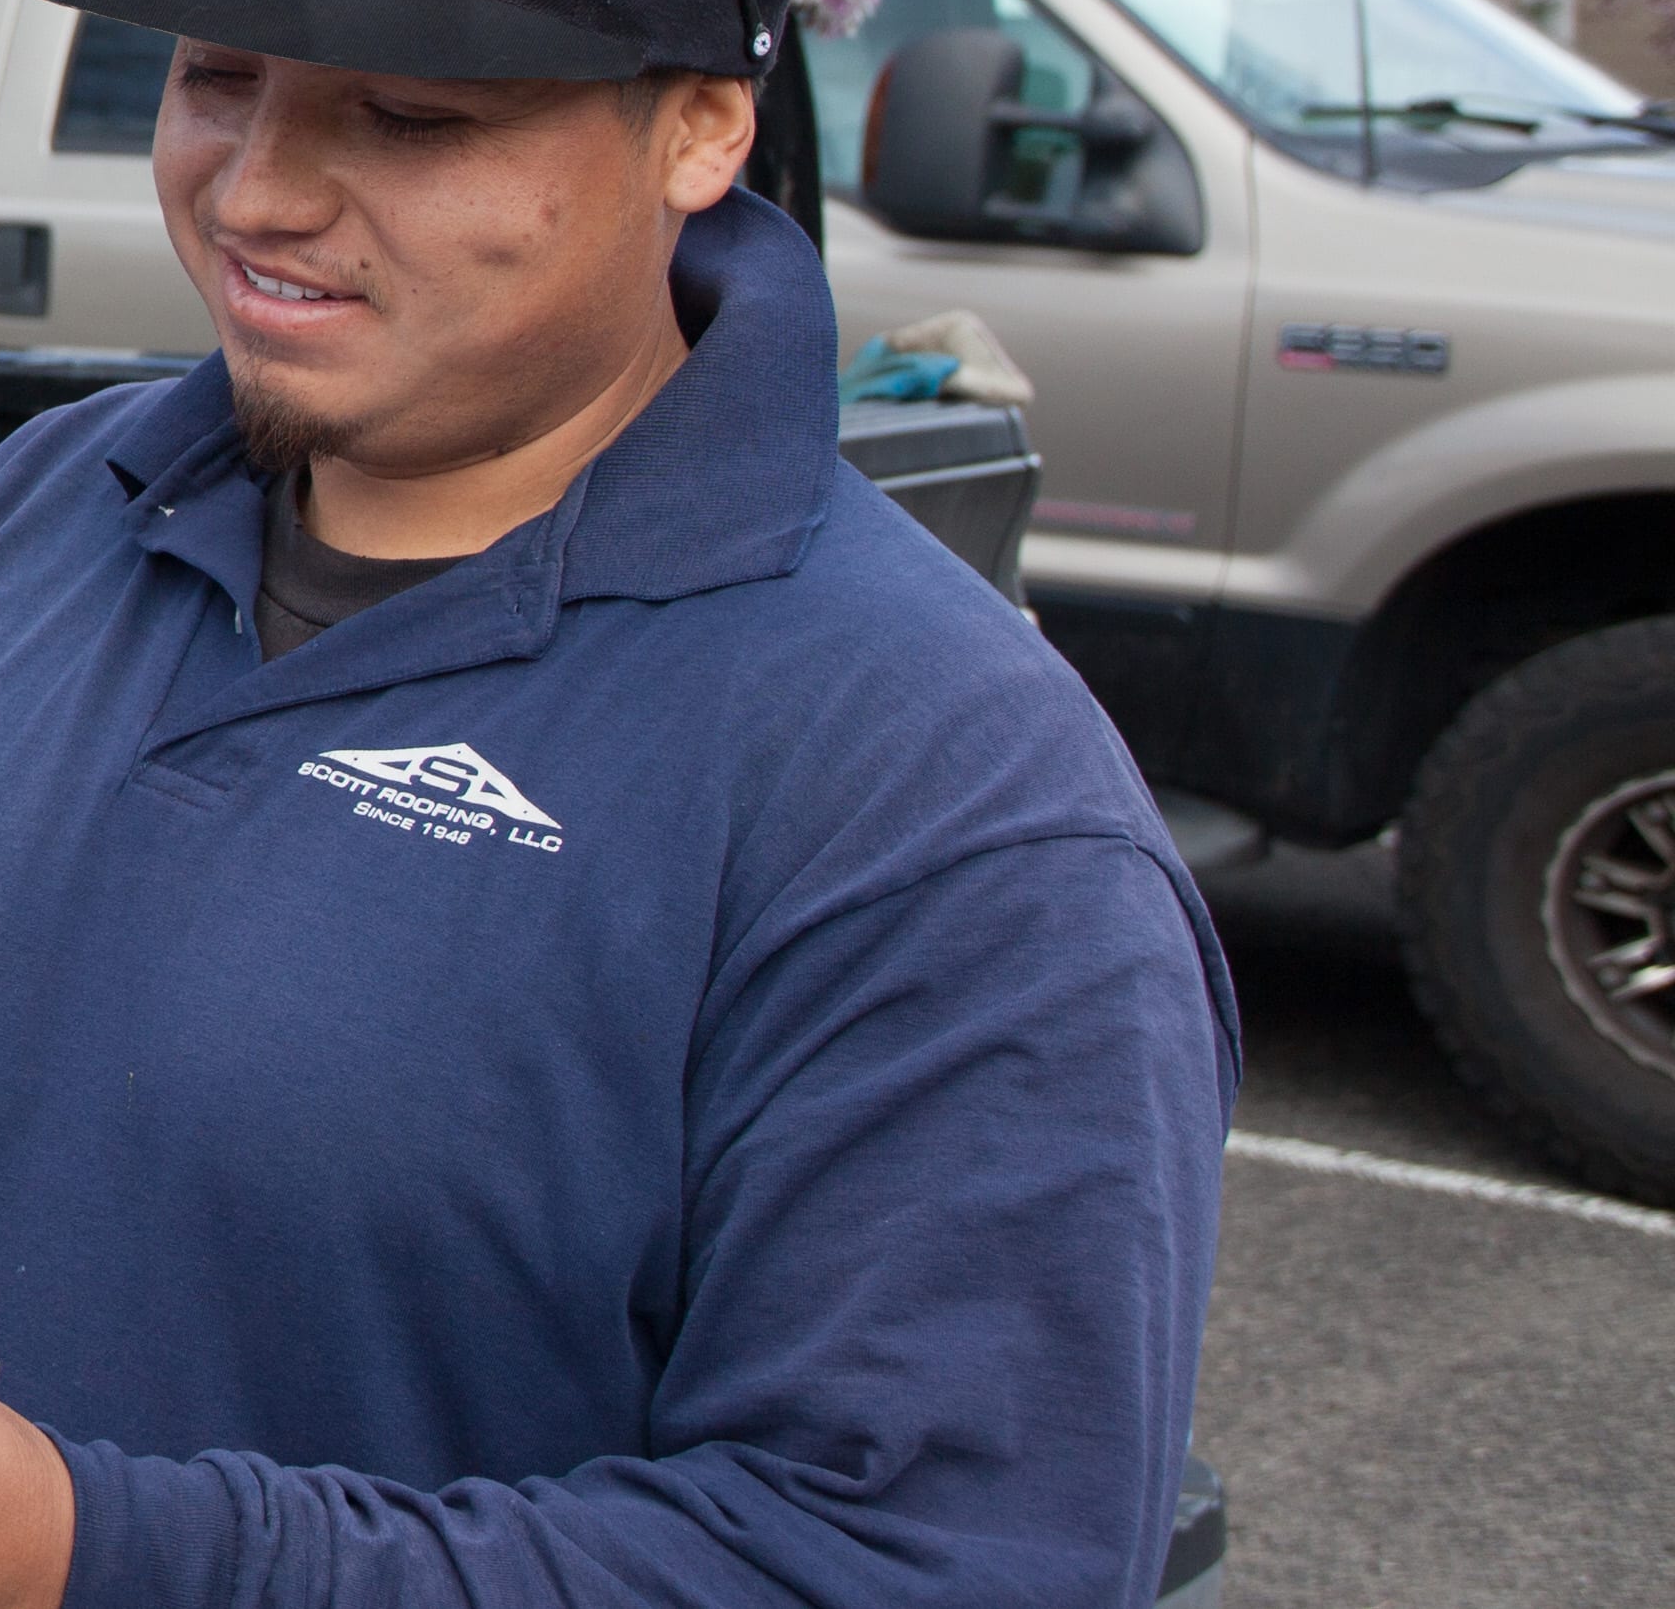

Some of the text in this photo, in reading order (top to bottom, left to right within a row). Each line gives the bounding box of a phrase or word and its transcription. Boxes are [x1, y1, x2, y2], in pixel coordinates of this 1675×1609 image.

[297, 761, 563, 854] SCOTT ROOFING, LLC
[352, 801, 472, 846] SINCE 1948
